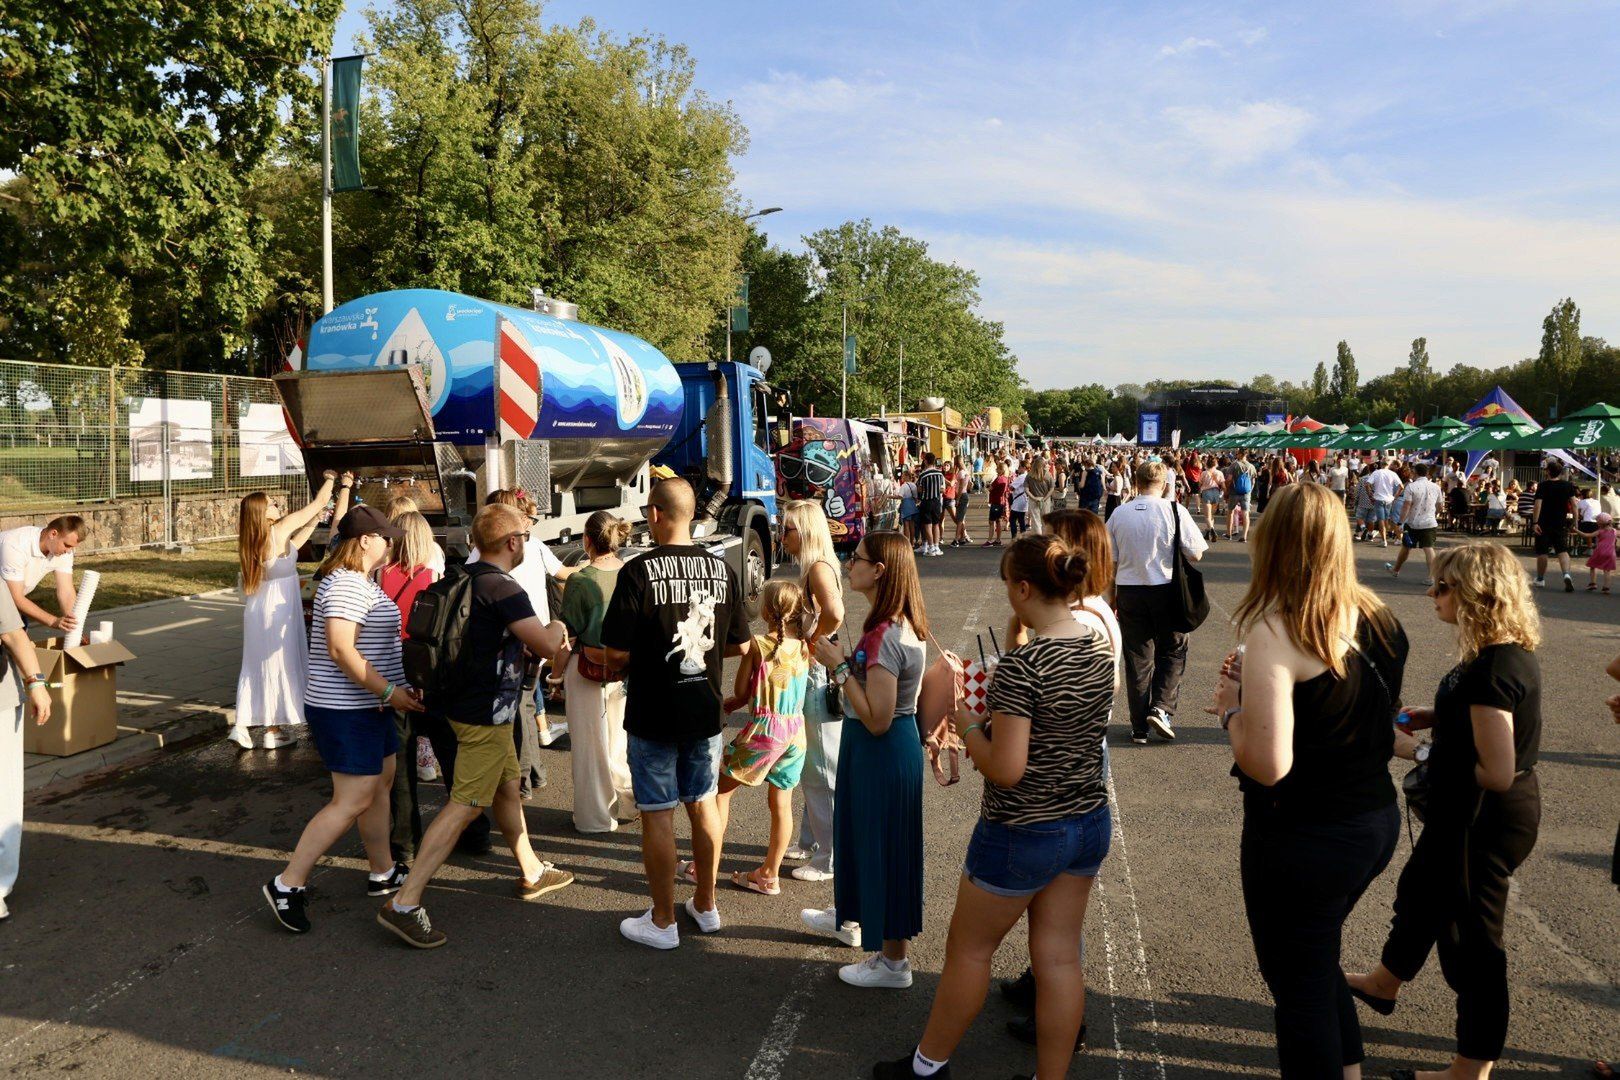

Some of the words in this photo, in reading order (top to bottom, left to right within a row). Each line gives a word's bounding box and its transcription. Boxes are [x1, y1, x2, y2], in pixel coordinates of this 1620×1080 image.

[320, 322, 357, 334] kranówka
[644, 556, 680, 581] ENJOY
[680, 556, 709, 579] YOUR
[707, 557, 728, 581] LIFE
[652, 580, 668, 605] TO
[669, 580, 688, 604] THE
